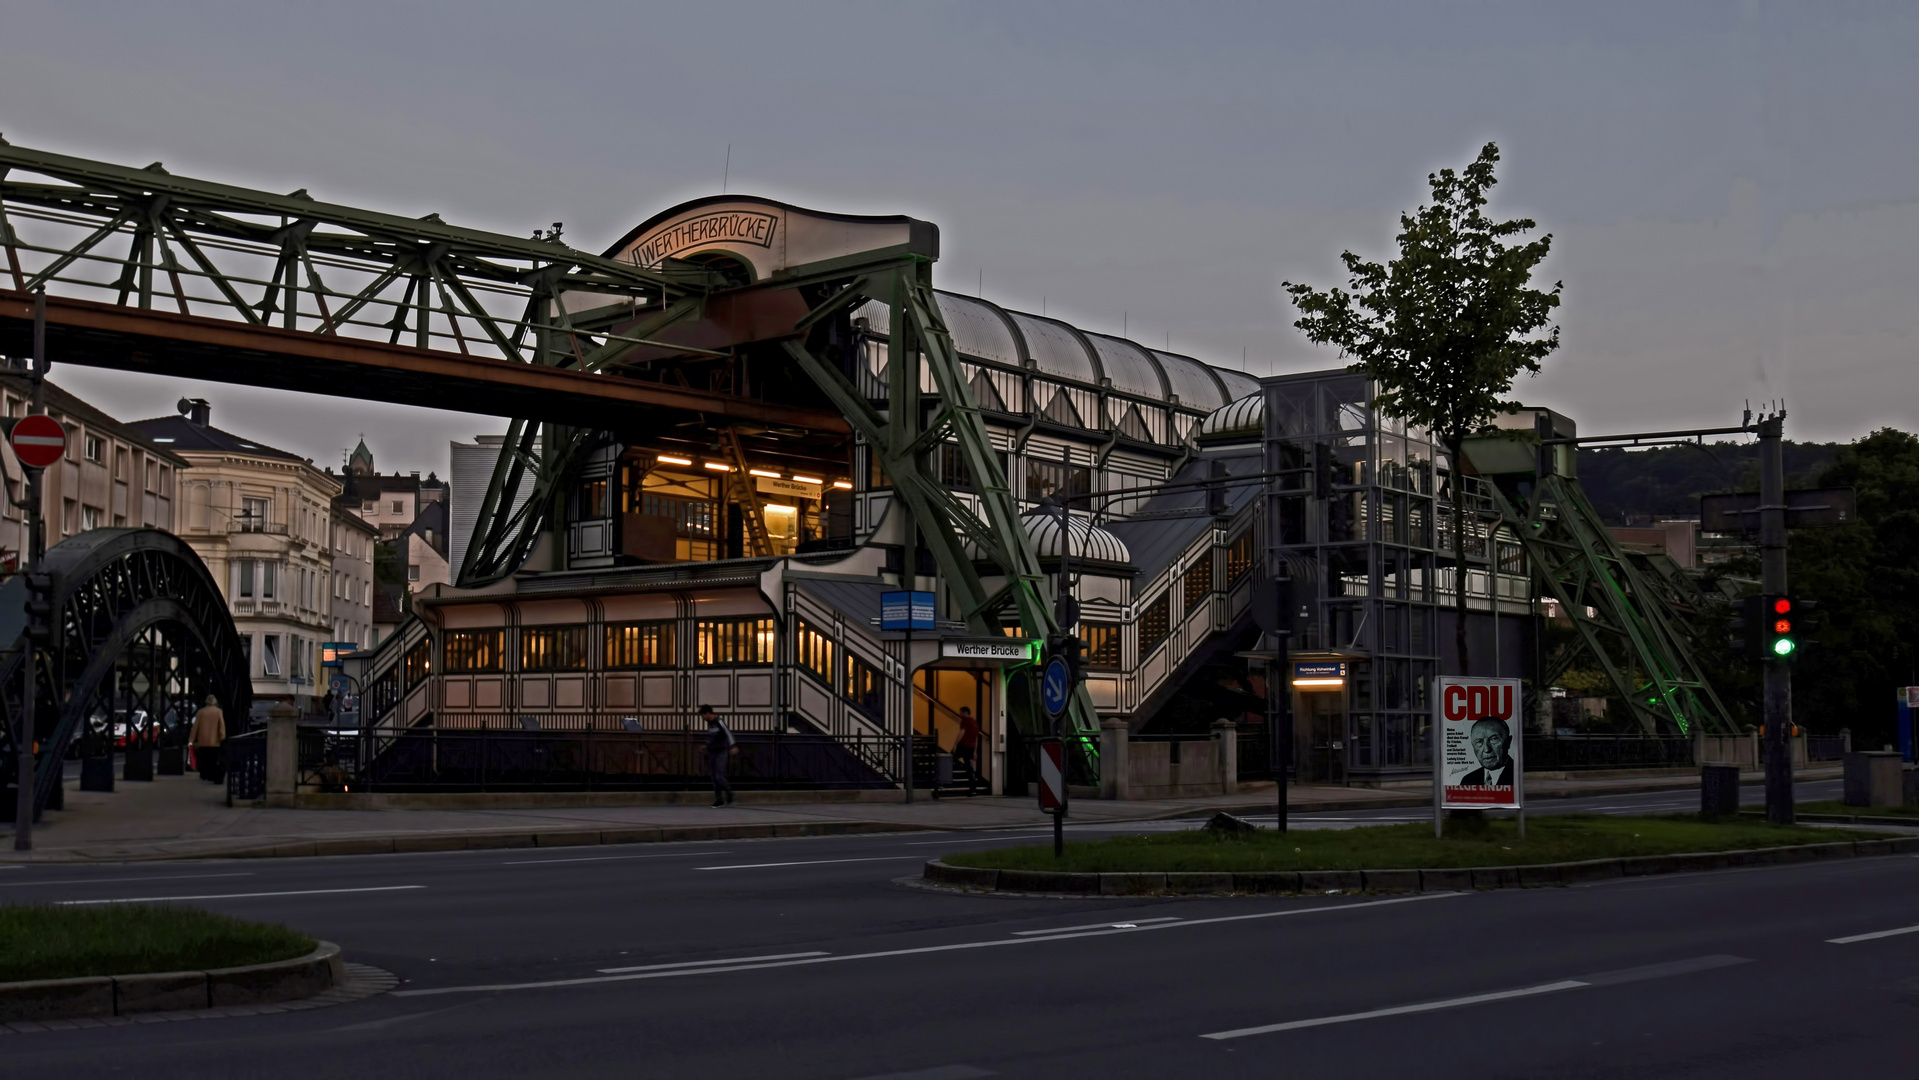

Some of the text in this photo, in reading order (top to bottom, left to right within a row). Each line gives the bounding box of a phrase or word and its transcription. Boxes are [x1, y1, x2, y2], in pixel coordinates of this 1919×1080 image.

[641, 214, 767, 265] WERTHERBRÜCKE
[957, 643, 1019, 656] Werther Brücke
[1444, 685, 1512, 721] CDU
